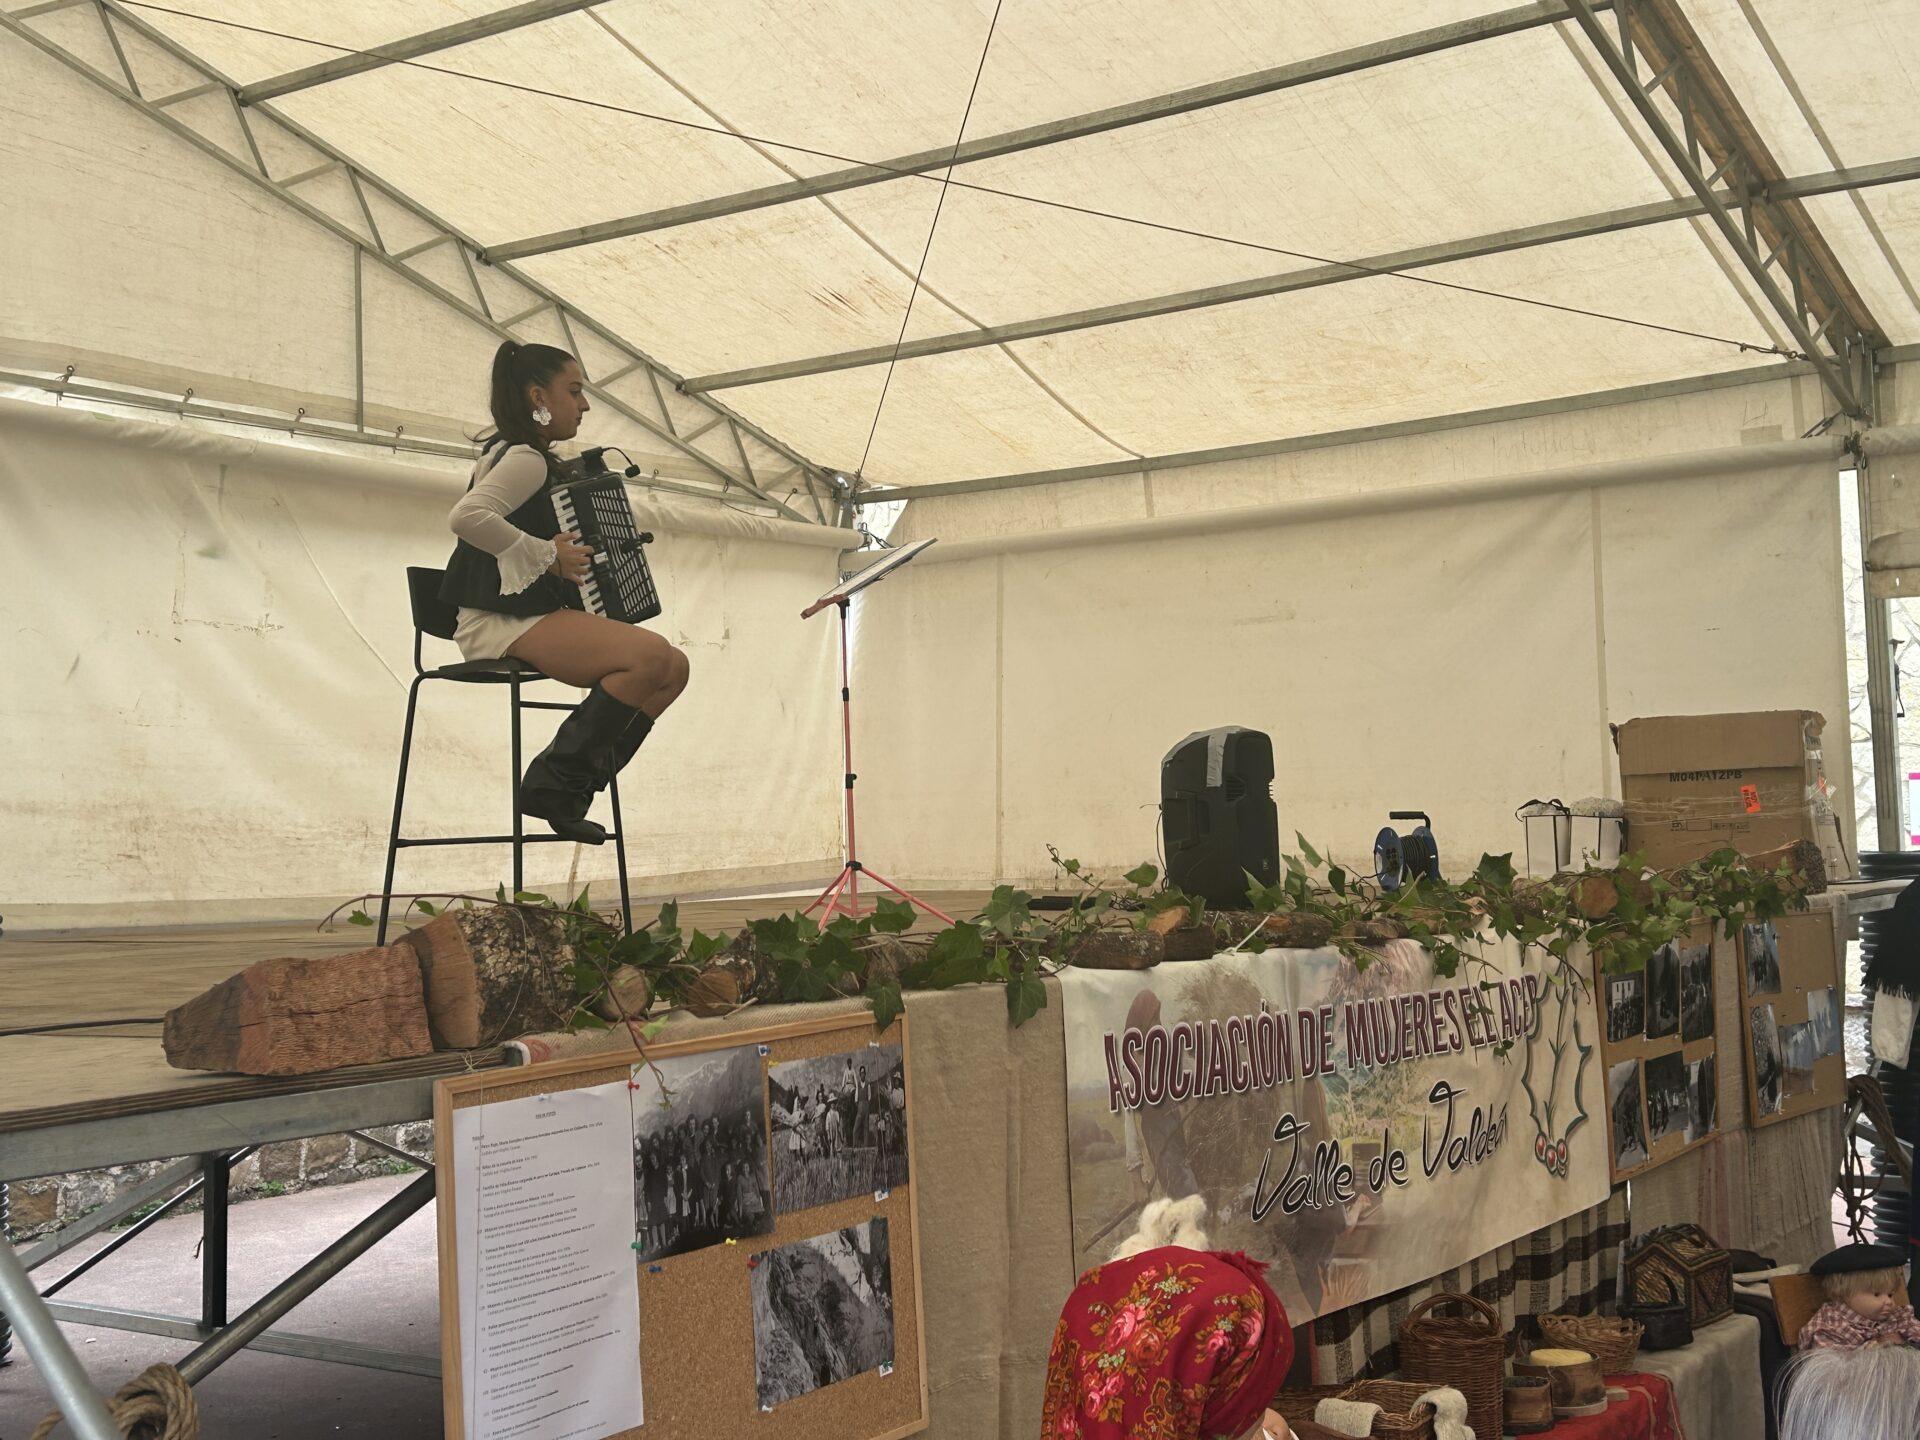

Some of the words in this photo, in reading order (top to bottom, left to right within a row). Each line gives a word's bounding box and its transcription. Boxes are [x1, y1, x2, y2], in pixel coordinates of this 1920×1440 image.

[1103, 998, 1294, 1113] ASOCIACIÓN
[1297, 1003, 1337, 1079] DE
[1344, 990, 1464, 1071] MUJERES
[1251, 1112, 1356, 1223] Valle
[1368, 1127, 1409, 1194] de
